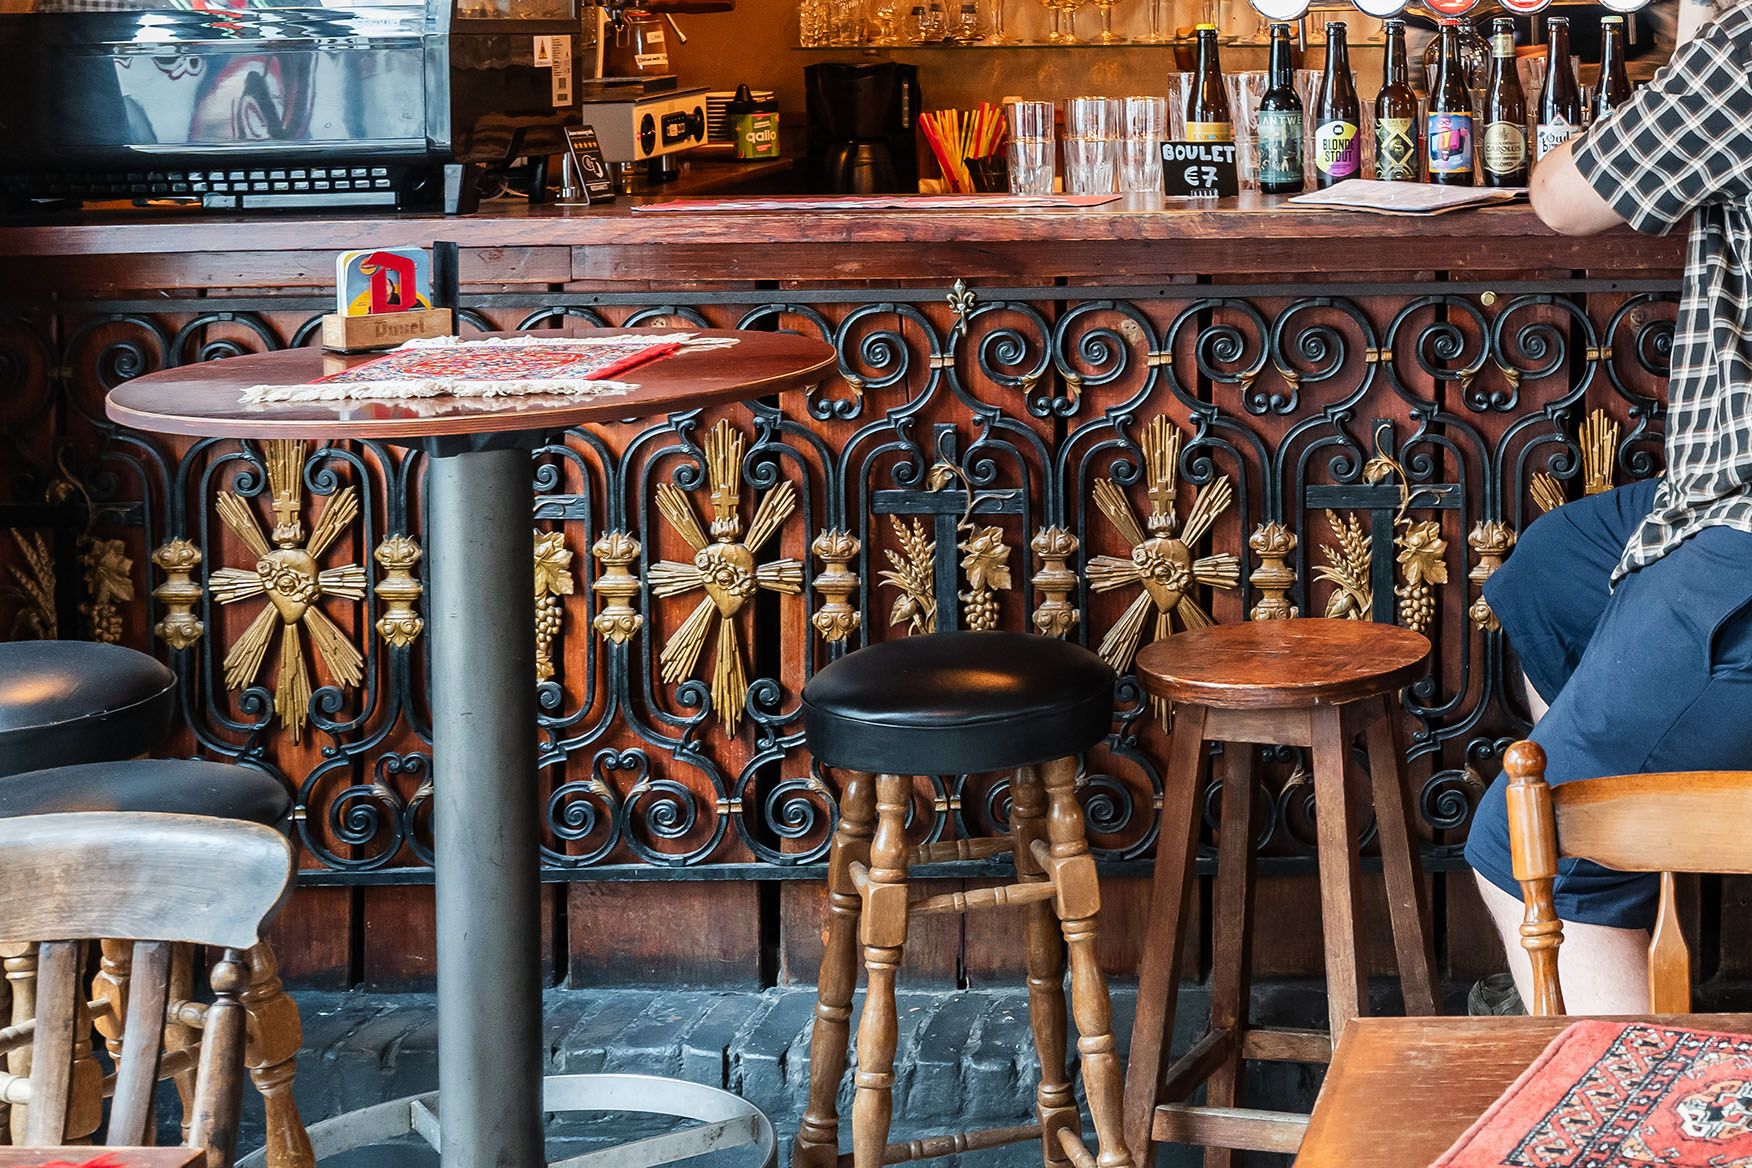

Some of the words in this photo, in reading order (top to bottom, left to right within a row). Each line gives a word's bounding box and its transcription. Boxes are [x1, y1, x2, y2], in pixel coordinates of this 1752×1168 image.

[1323, 138, 1354, 150] BLONDE
[1486, 145, 1521, 153] CAROLUS
[1162, 143, 1236, 164] BOULET
[1325, 150, 1352, 162] STOUT
[1184, 165, 1218, 188] €7
[375, 319, 425, 338] Duvel
